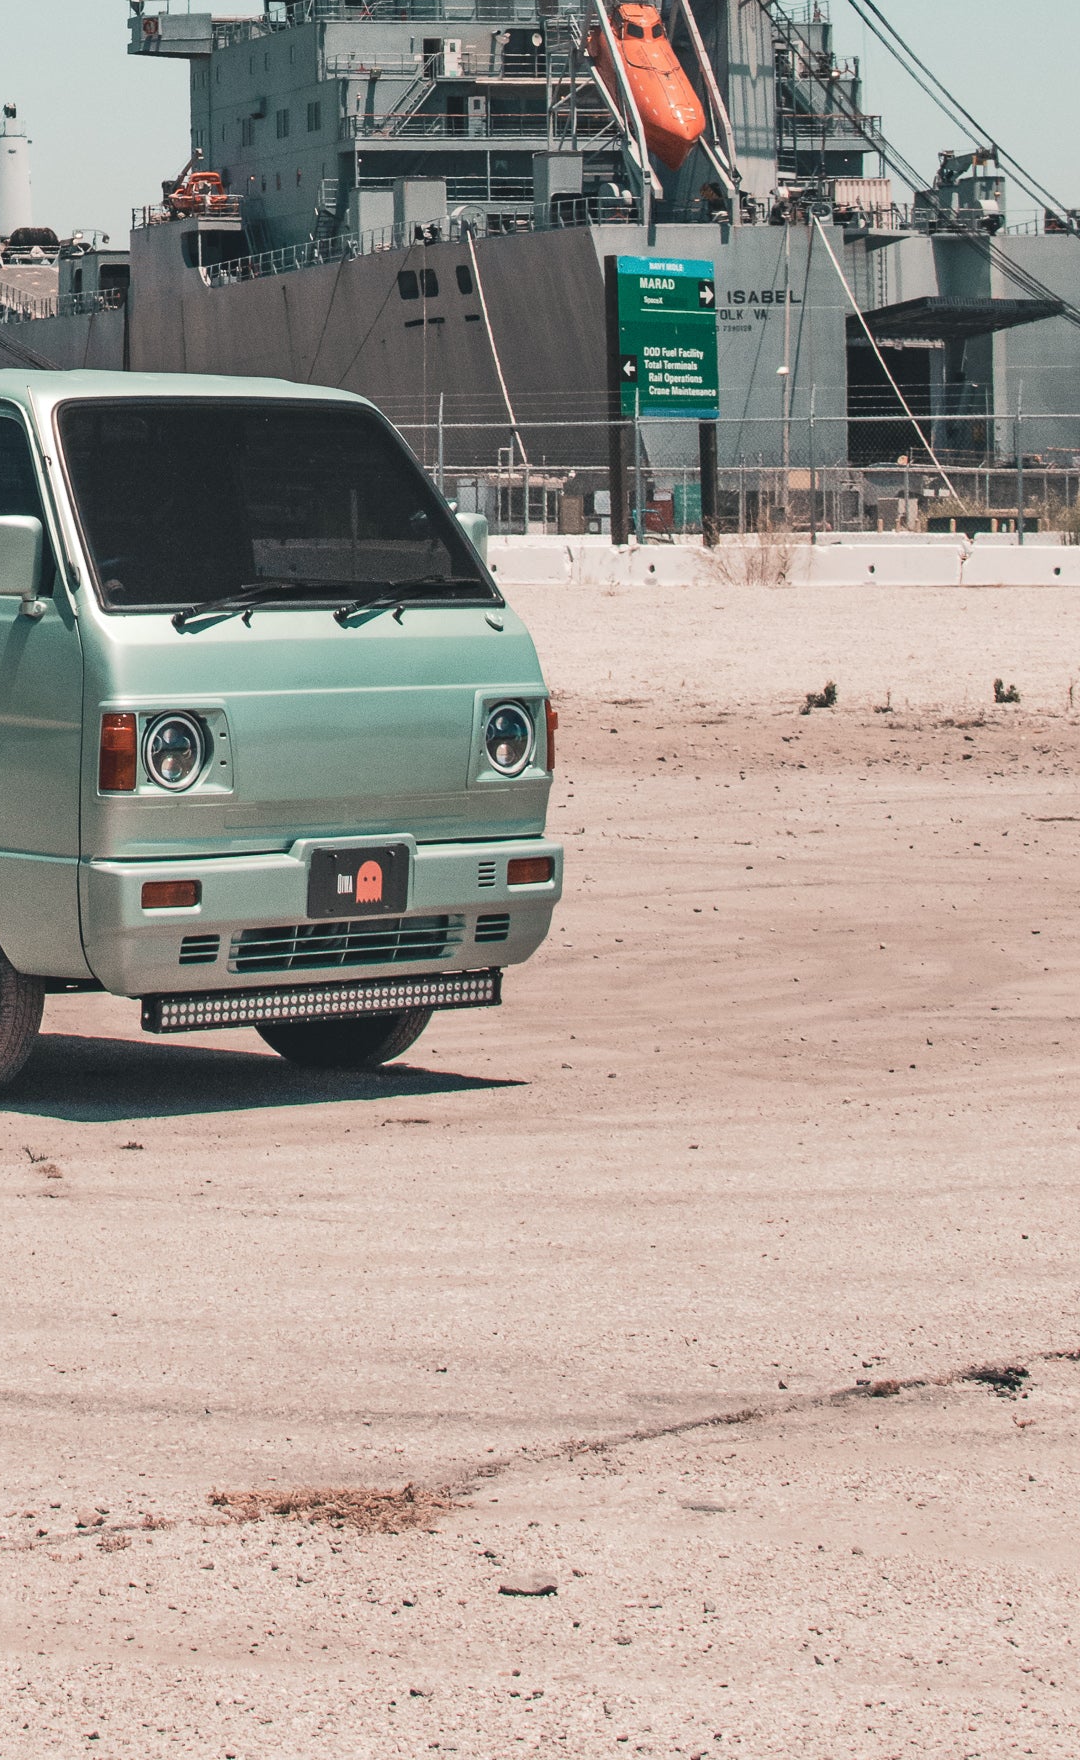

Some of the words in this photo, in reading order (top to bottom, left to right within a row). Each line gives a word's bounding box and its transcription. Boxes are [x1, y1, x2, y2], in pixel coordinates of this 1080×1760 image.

[639, 277, 675, 290] MARAD
[643, 296, 663, 304] SpaceX
[727, 290, 801, 304] ISABEL
[643, 346, 660, 356] DOD
[661, 347, 677, 357] Fuel
[678, 348, 704, 359] Facility
[643, 359, 662, 369] Total
[663, 360, 698, 370] Terminals
[648, 372, 663, 382] Rail
[664, 373, 703, 384] Operations
[649, 385, 670, 395] Crane
[671, 386, 717, 397] Maintenance
